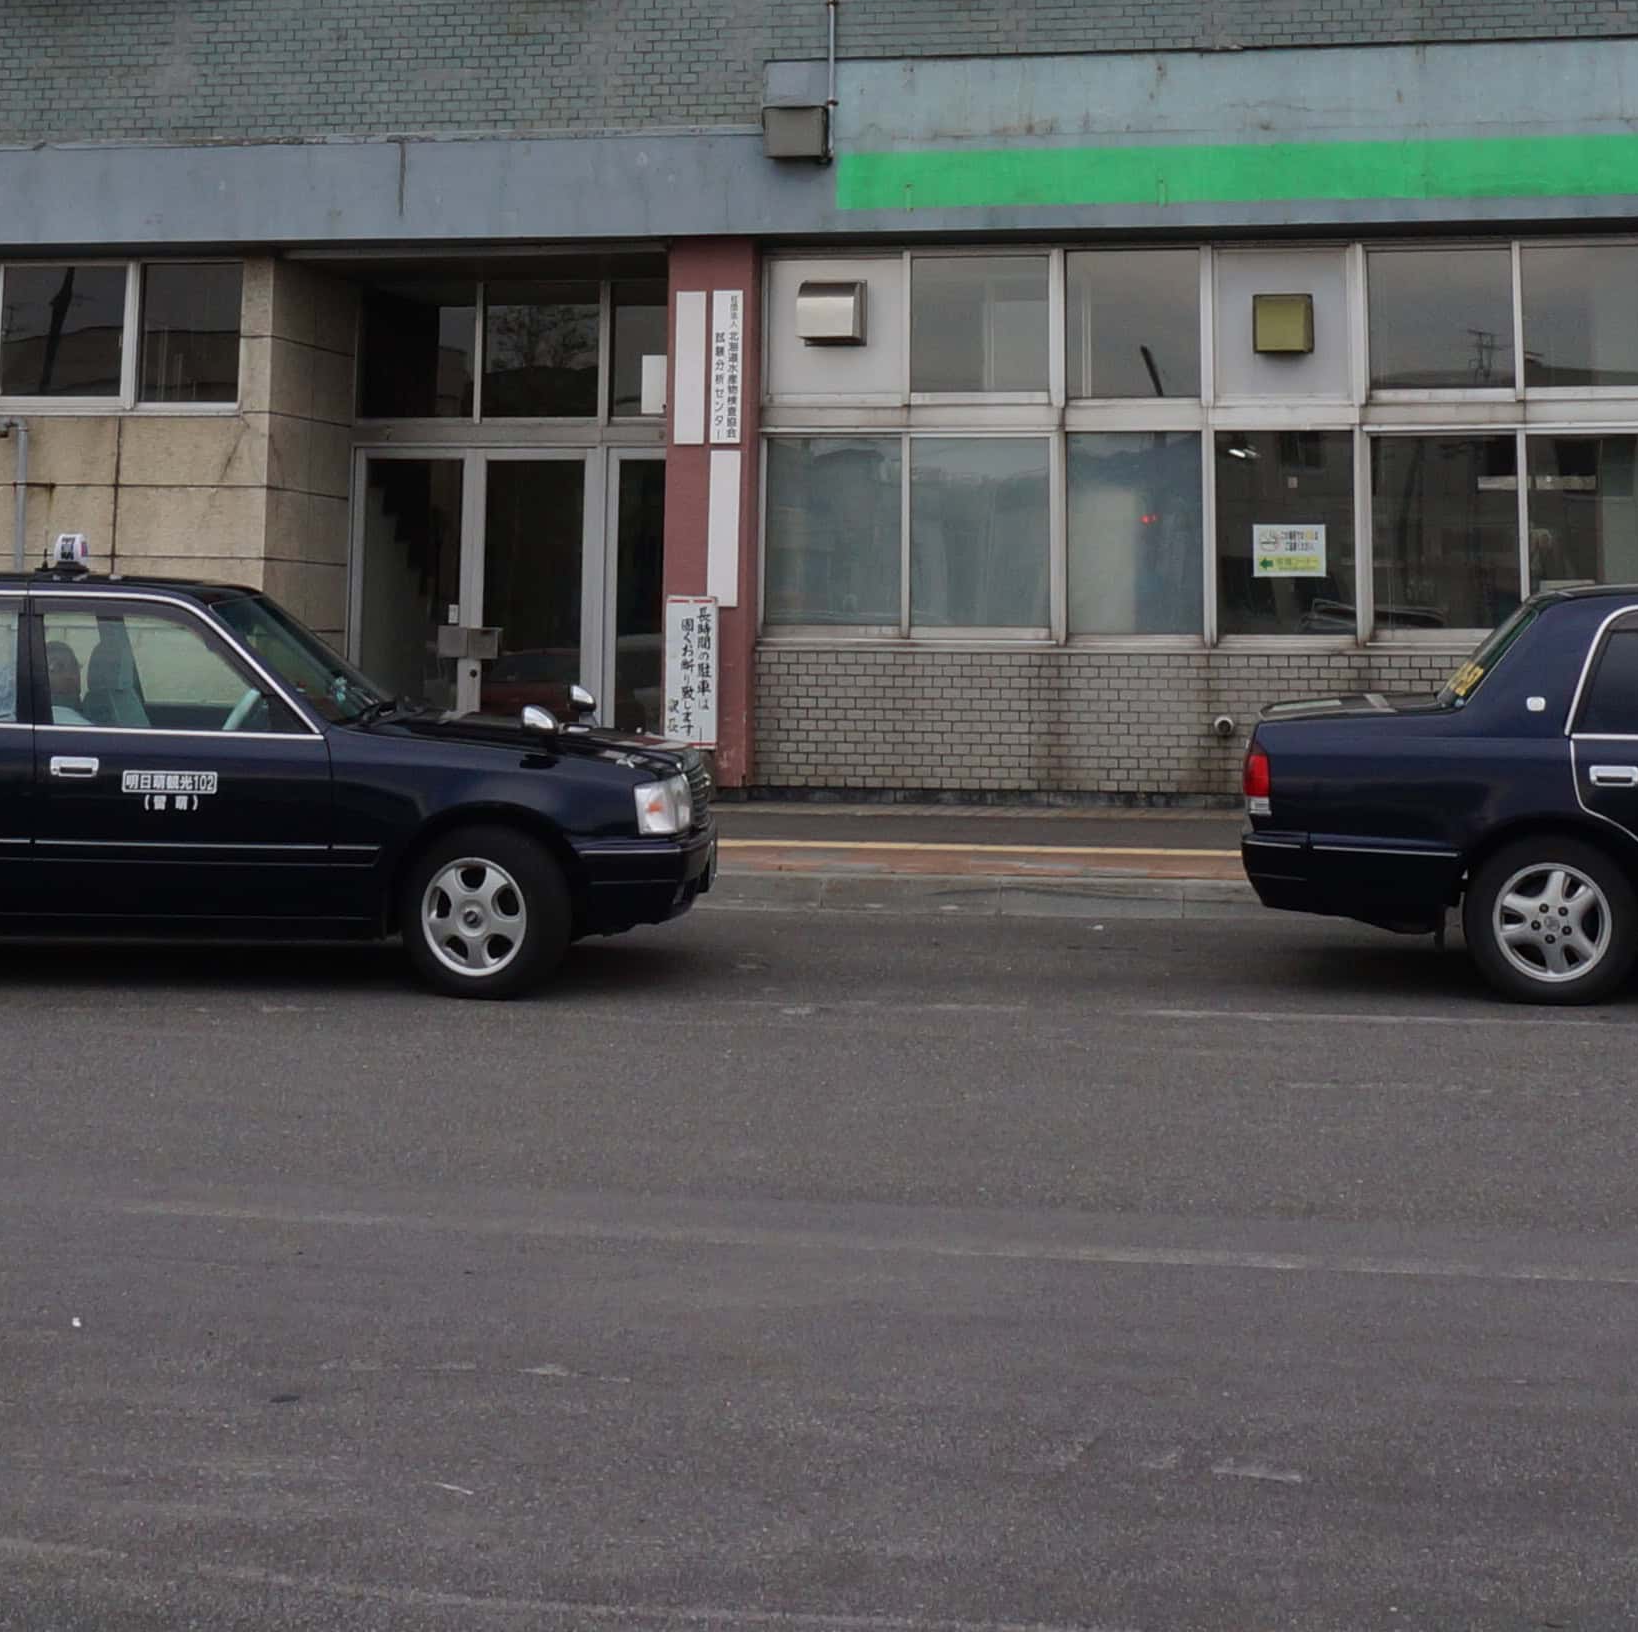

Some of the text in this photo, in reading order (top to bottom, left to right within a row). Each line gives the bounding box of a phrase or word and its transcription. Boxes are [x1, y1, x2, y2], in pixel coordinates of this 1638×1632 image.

[697, 607, 712, 711] 長時間の駐車は
